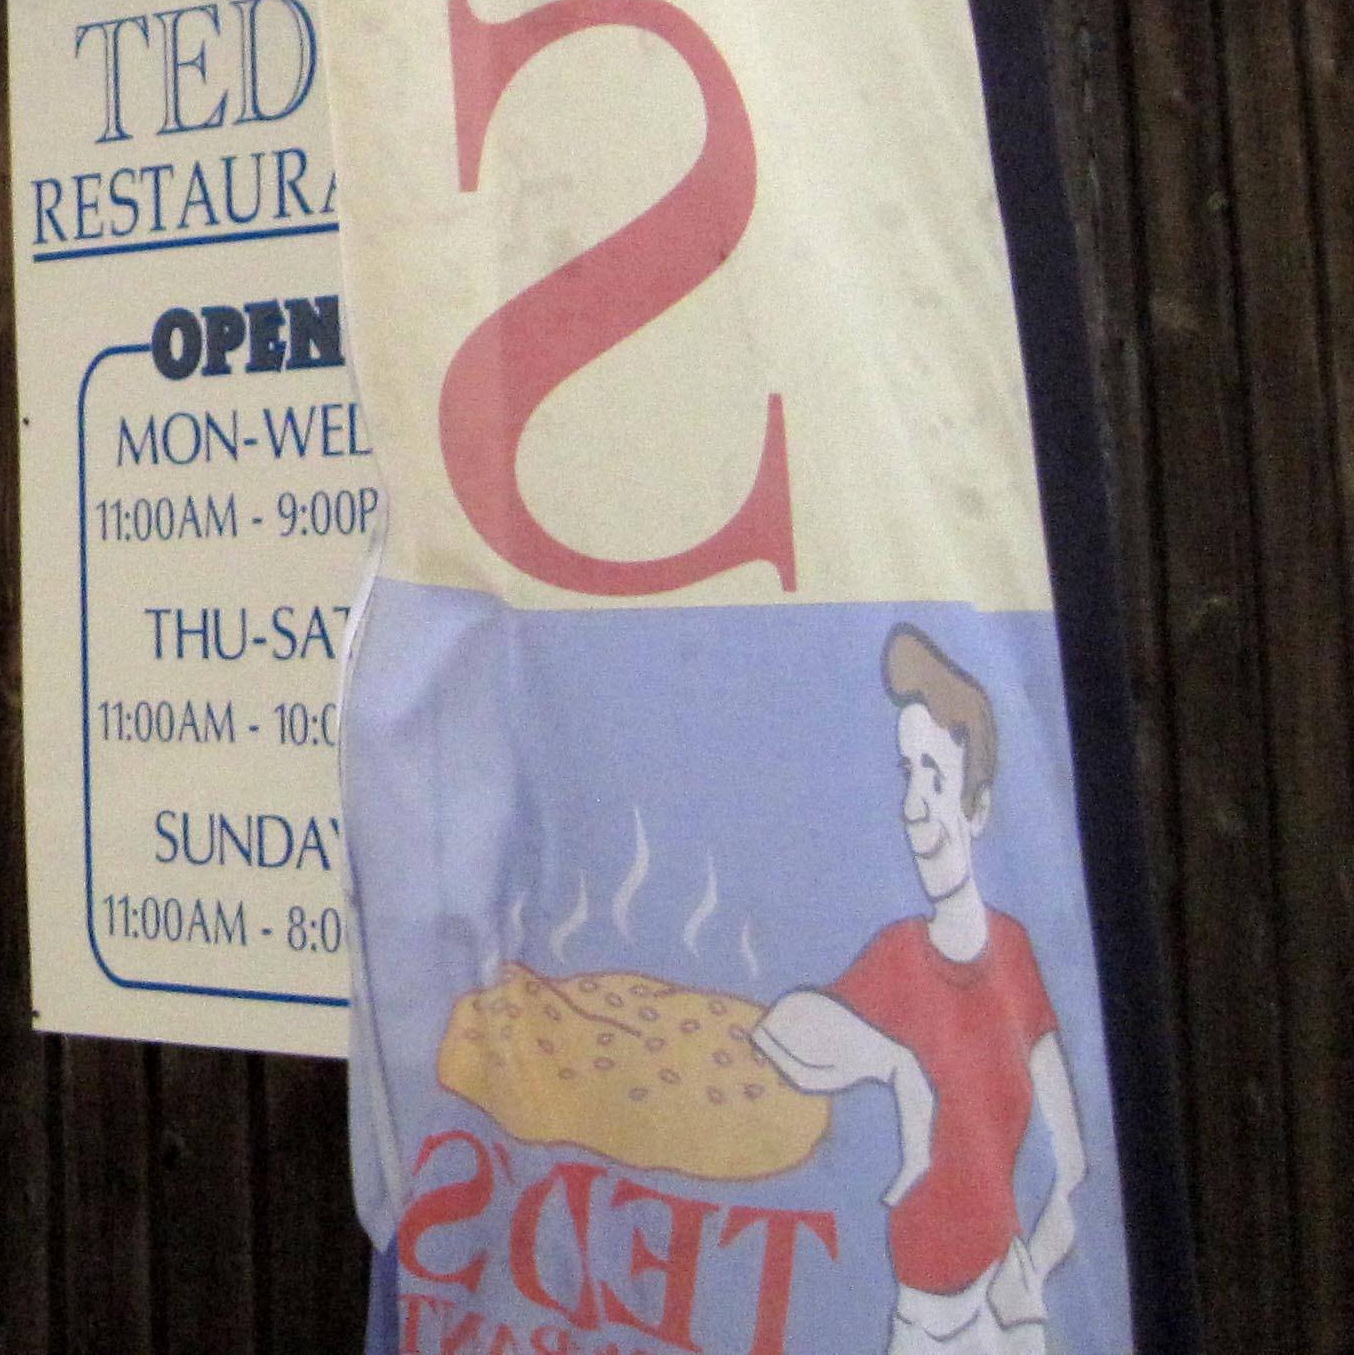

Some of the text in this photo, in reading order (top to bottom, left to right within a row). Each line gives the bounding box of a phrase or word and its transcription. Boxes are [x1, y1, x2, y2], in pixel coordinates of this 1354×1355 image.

[151, 295, 345, 381] OPEN
[97, 493, 238, 541] 11:00AM
[98, 700, 236, 744] 11:00AM
[103, 894, 247, 947] 11:00AM
